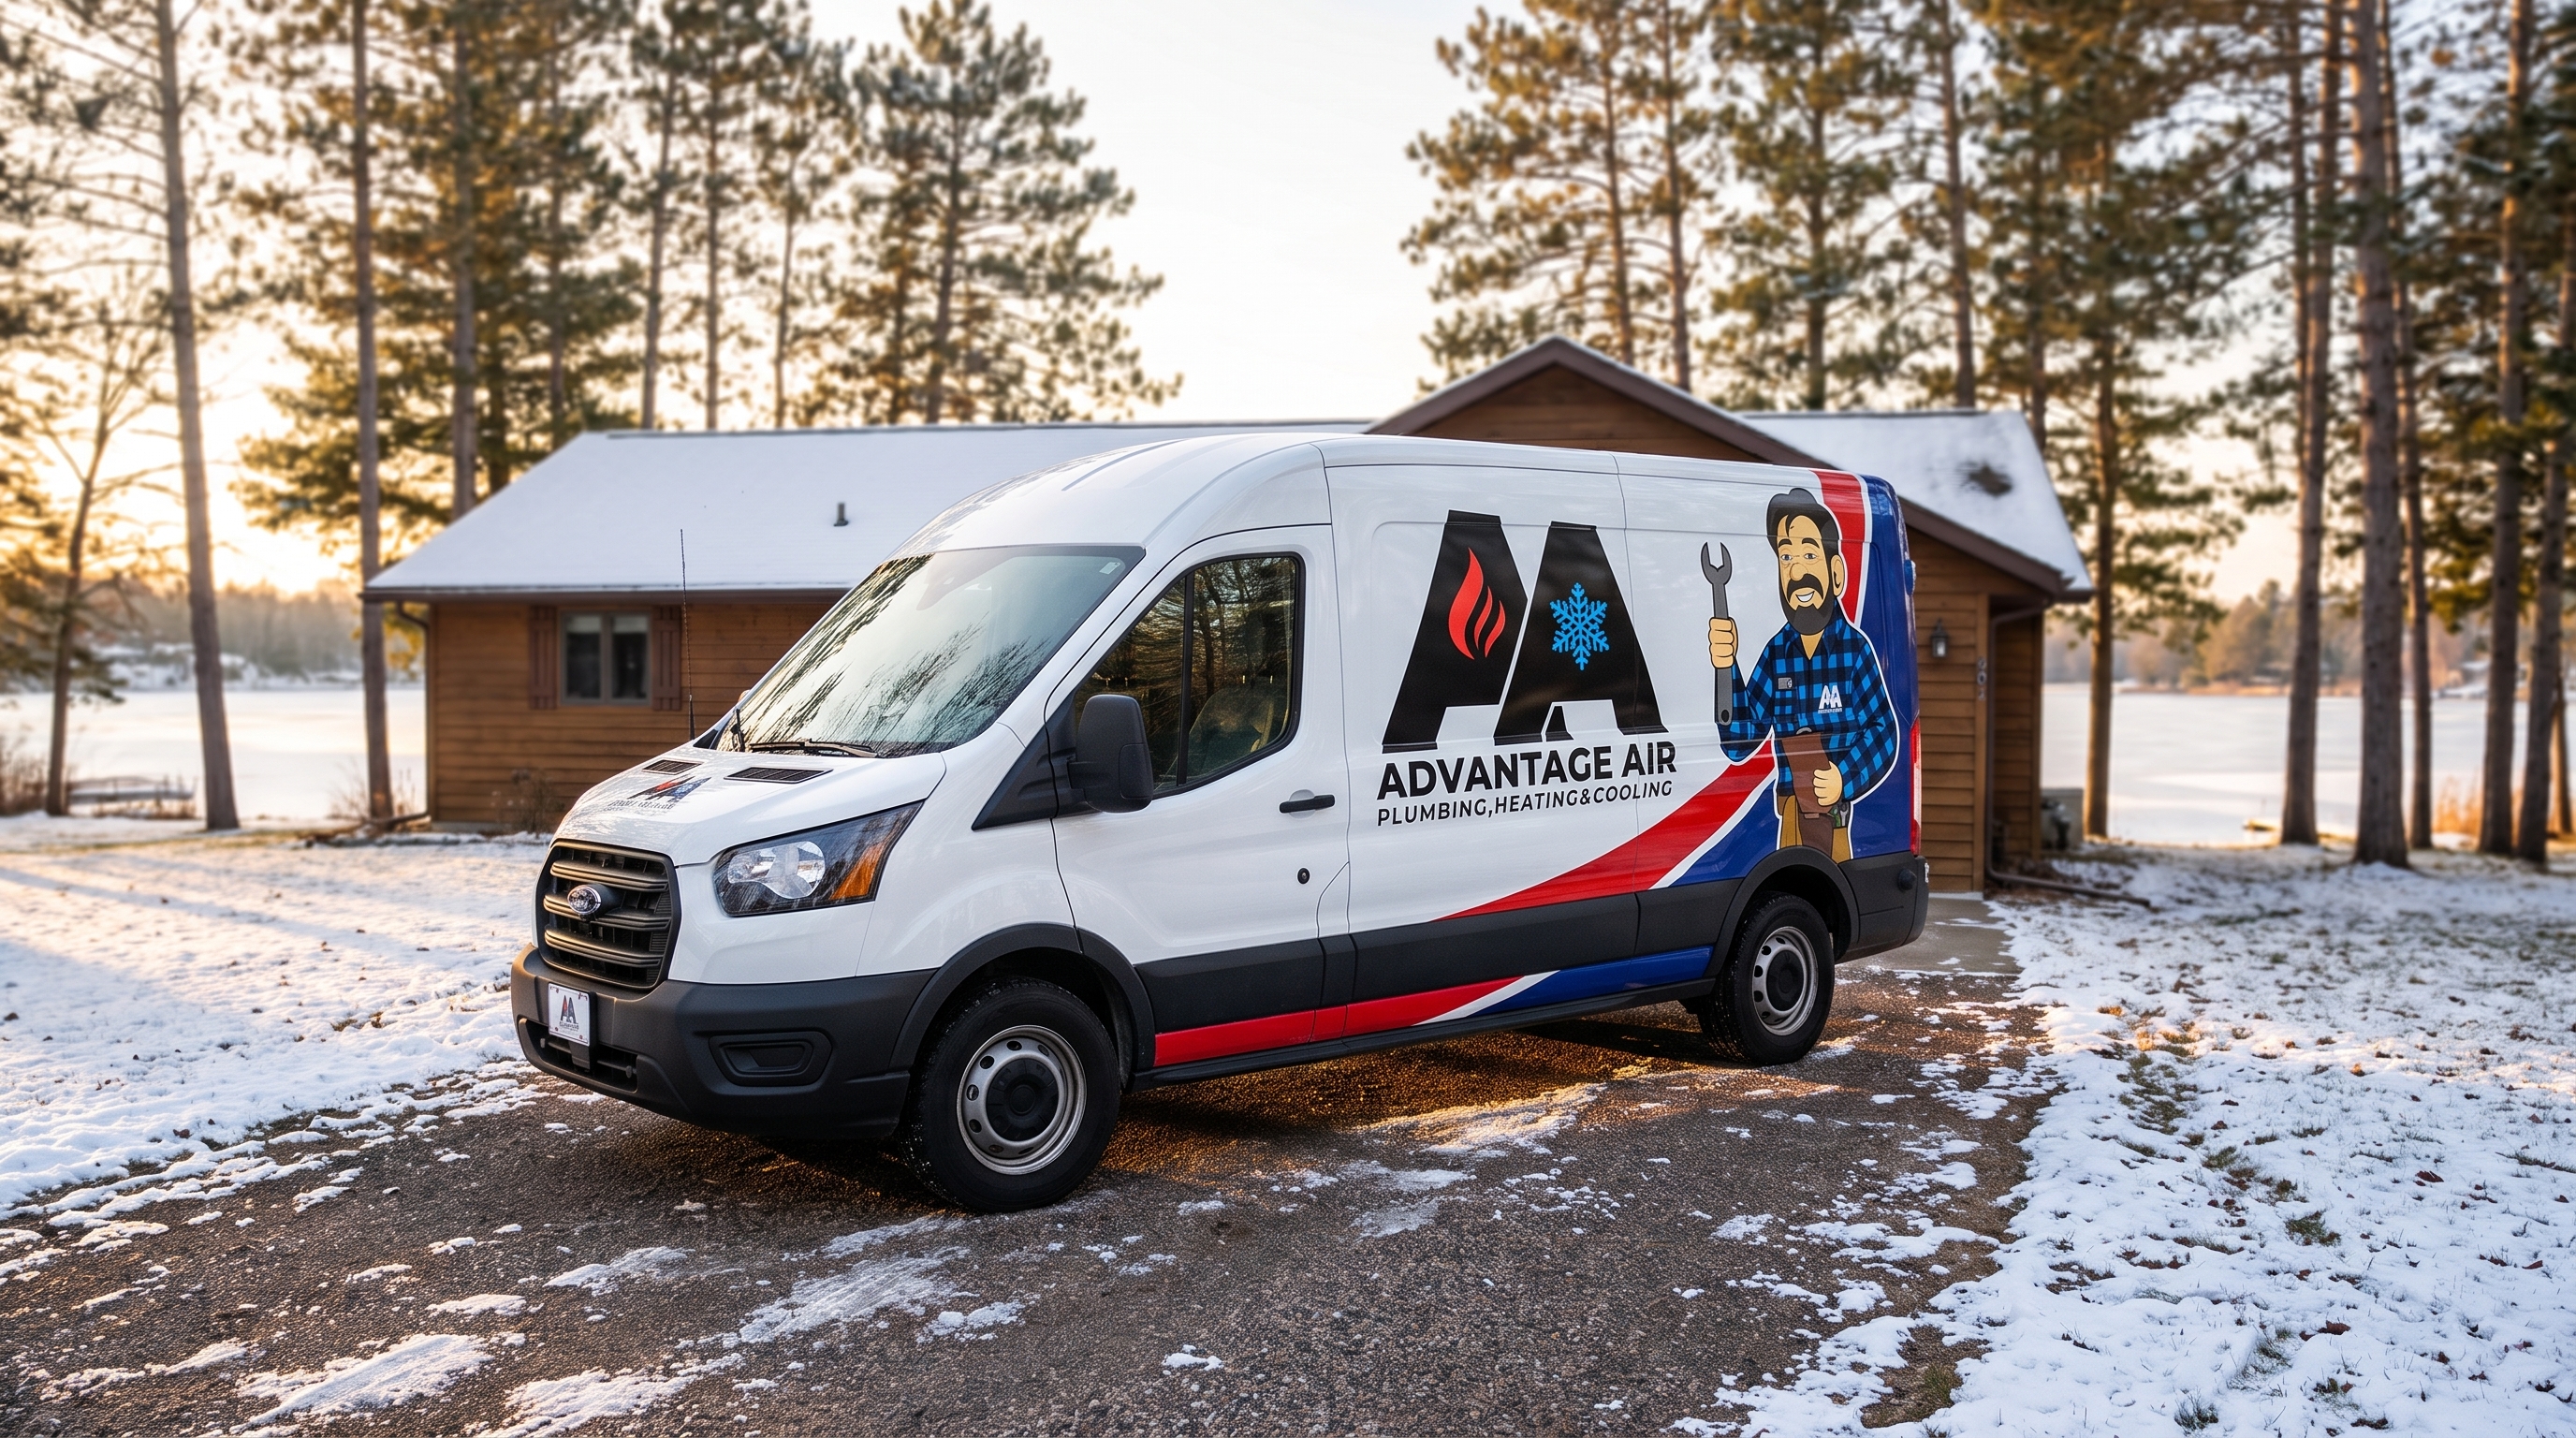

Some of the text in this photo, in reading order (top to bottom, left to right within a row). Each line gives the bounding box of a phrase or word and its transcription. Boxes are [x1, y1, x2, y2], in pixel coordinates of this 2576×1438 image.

[1377, 741, 1677, 800] ADVANTAGE AIR
[1377, 780, 1673, 826] PLUMBING,HEATING&COOLING
